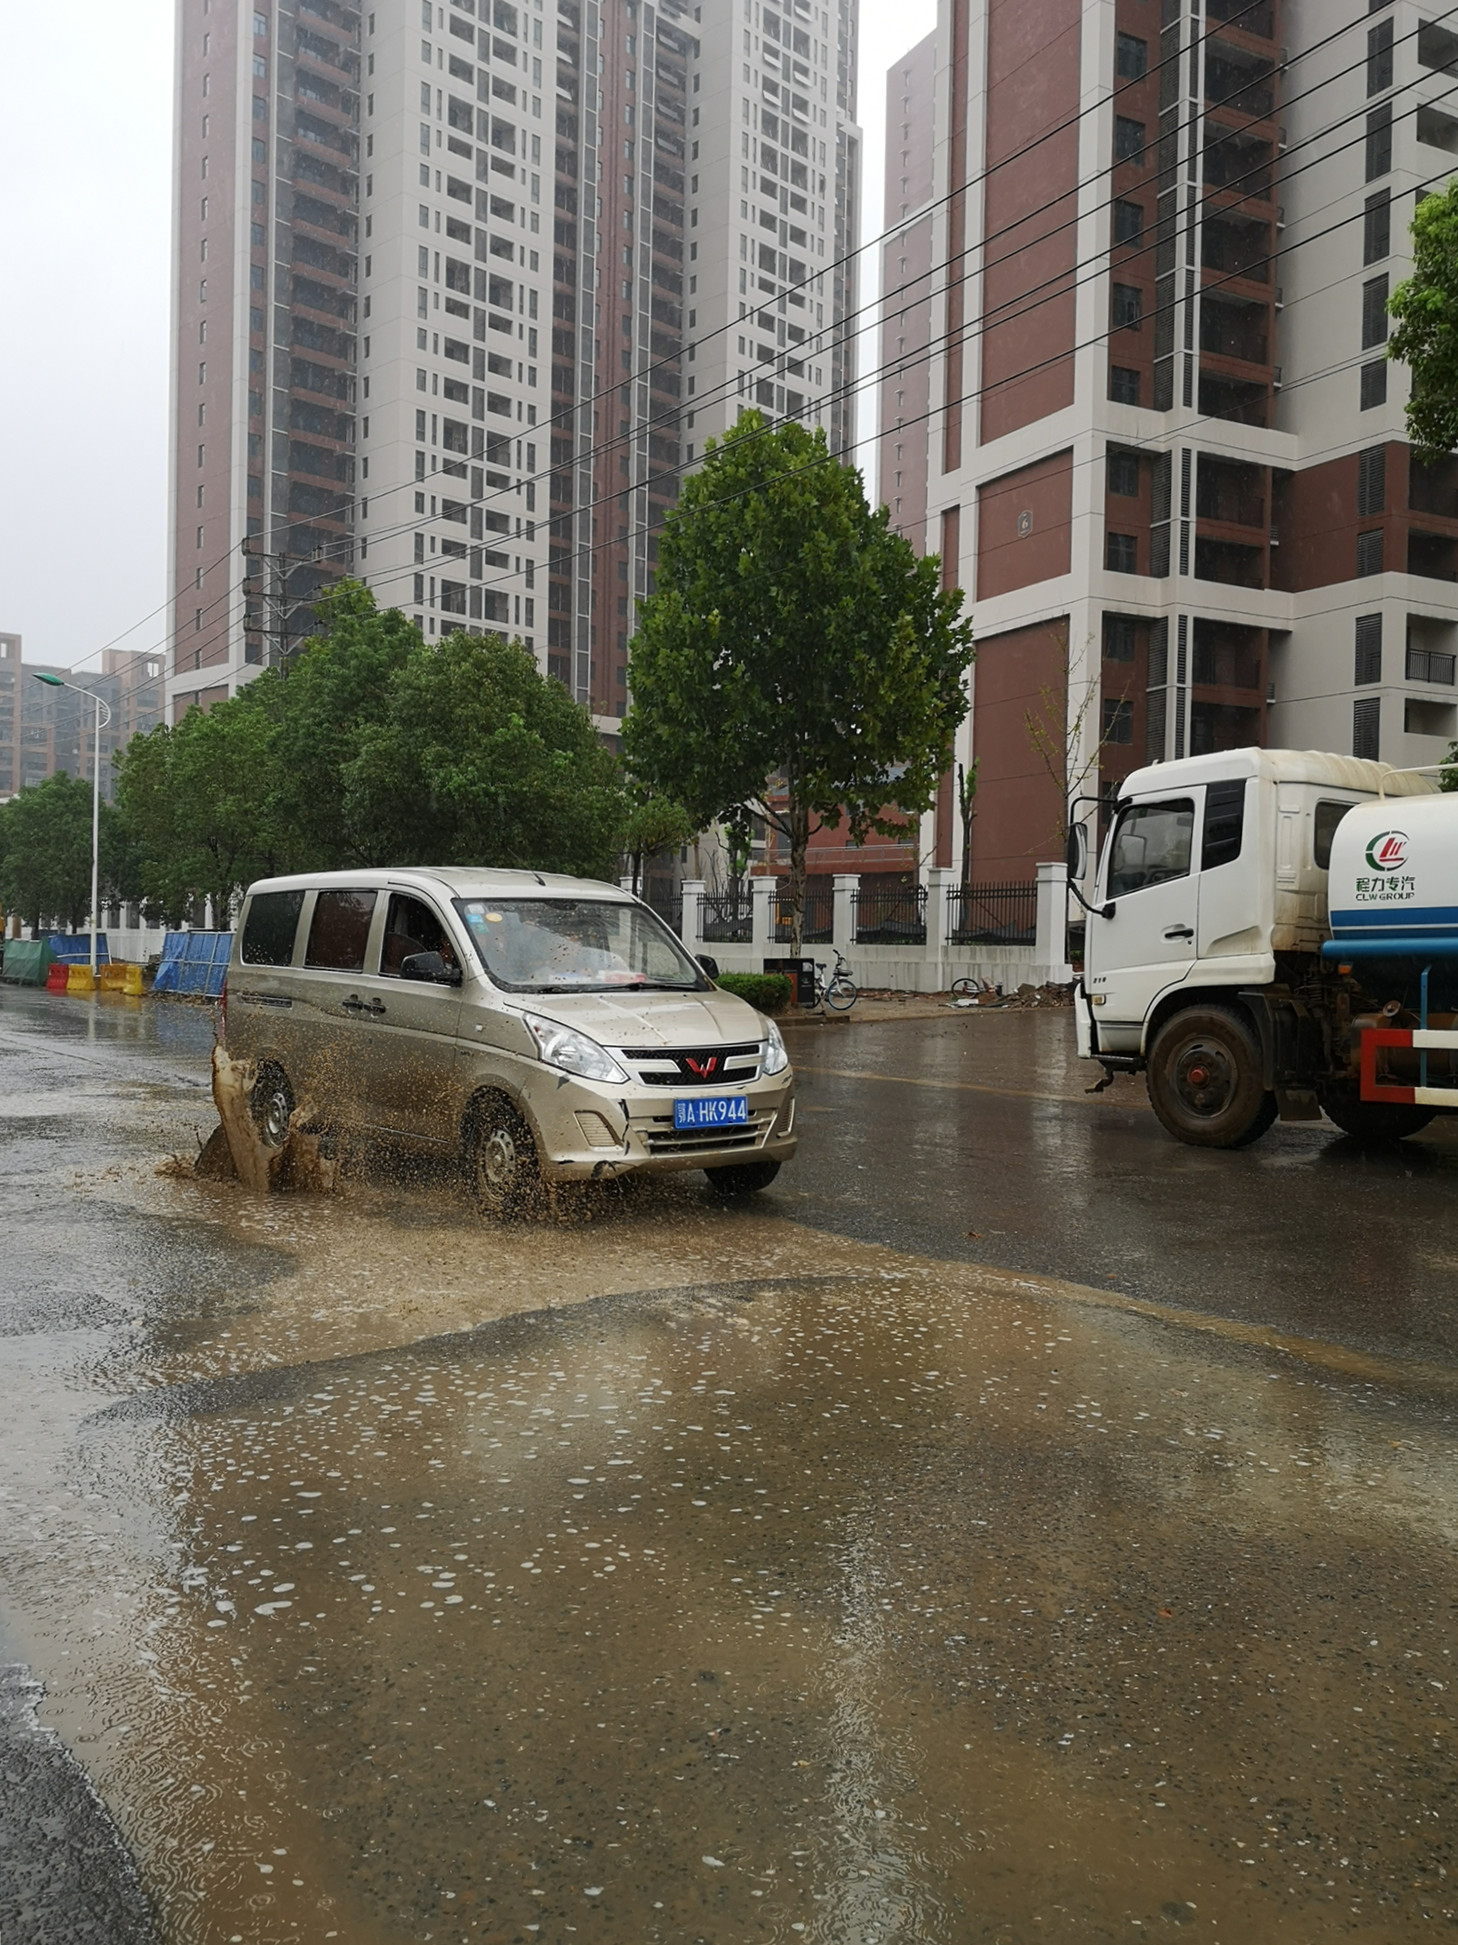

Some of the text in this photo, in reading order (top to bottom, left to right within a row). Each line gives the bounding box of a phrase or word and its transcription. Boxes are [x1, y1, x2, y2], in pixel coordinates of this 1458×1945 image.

[1356, 876, 1416, 892] 程力专汽
[1355, 892, 1415, 901] CLW GROUP
